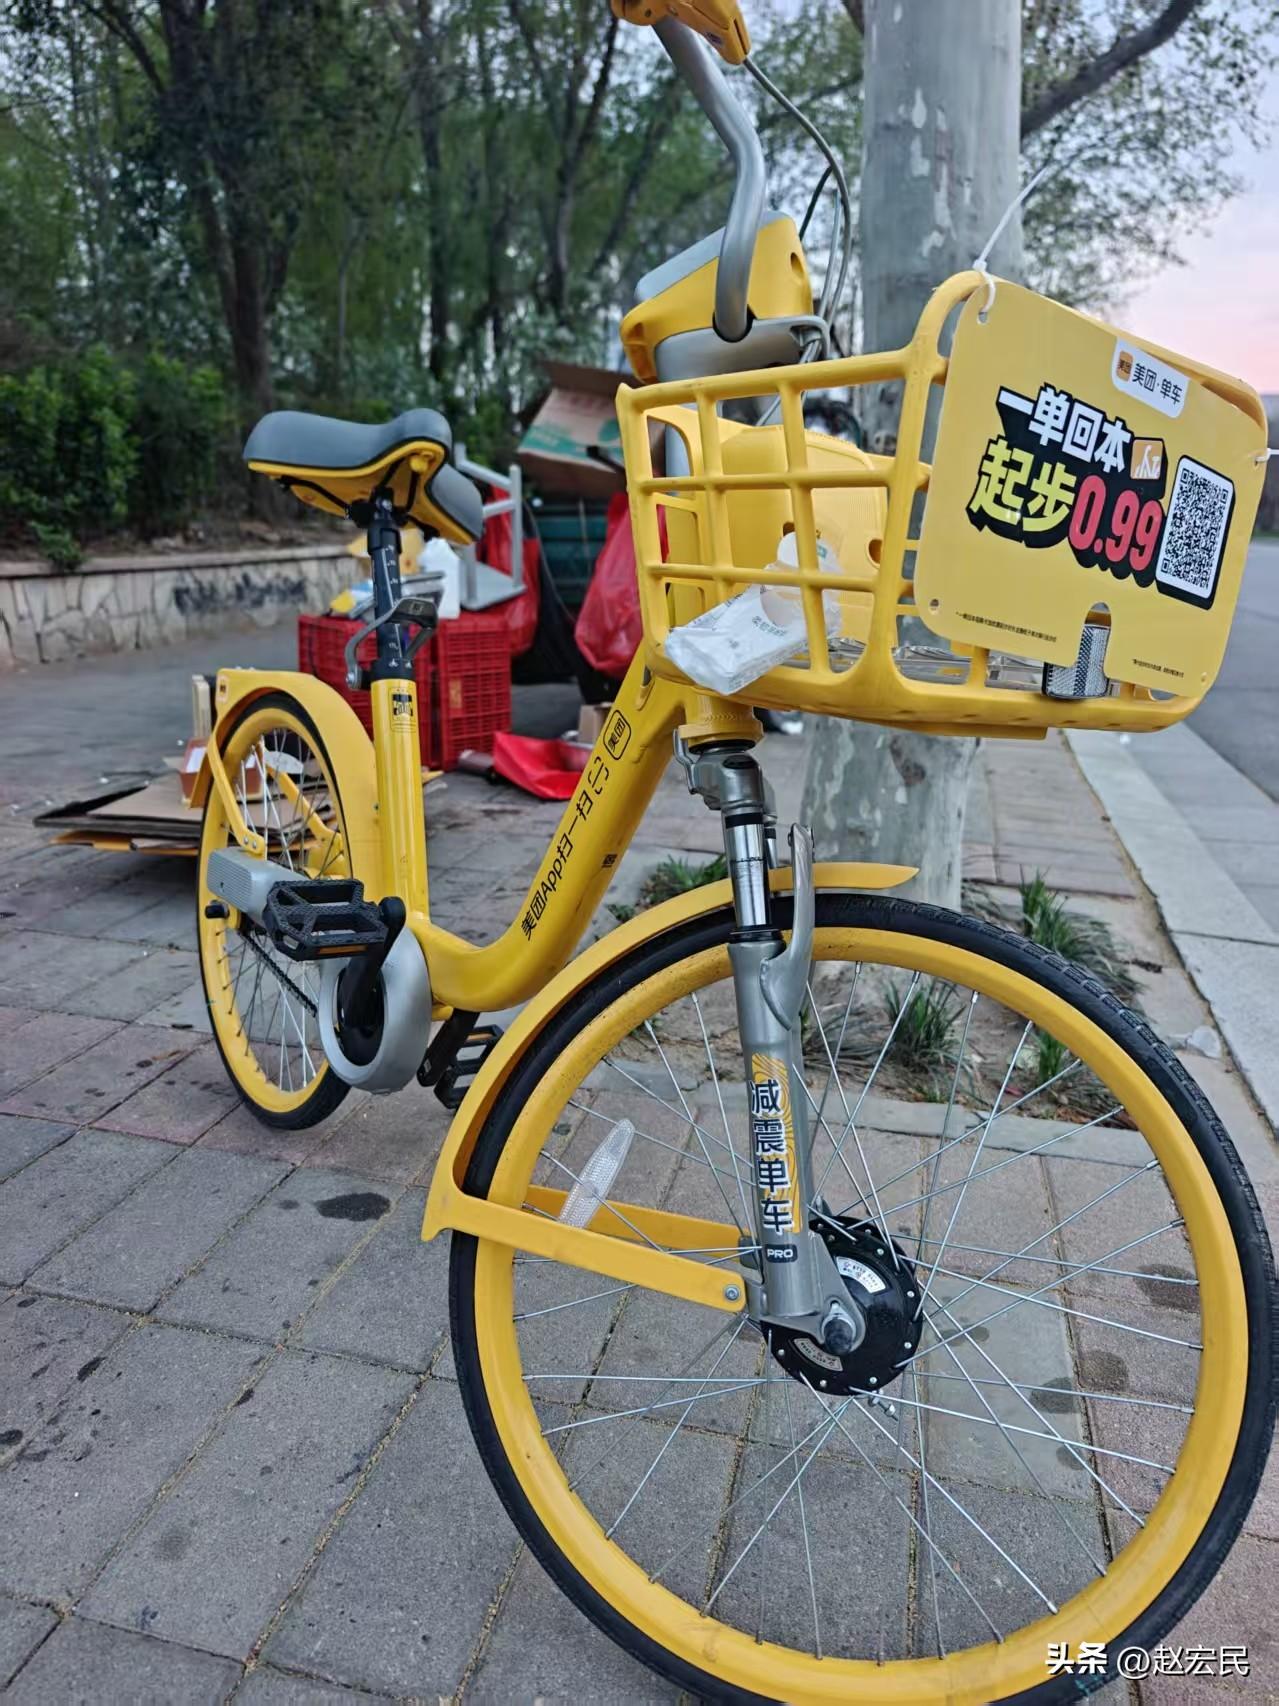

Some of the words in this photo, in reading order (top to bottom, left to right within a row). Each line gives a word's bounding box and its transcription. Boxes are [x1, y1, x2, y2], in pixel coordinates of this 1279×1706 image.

[998, 386, 1132, 473] 一单回本
[521, 789, 593, 941] 美团App扫一扫
[751, 1078, 793, 1234] 减震单车
[767, 1248, 794, 1259] PRO
